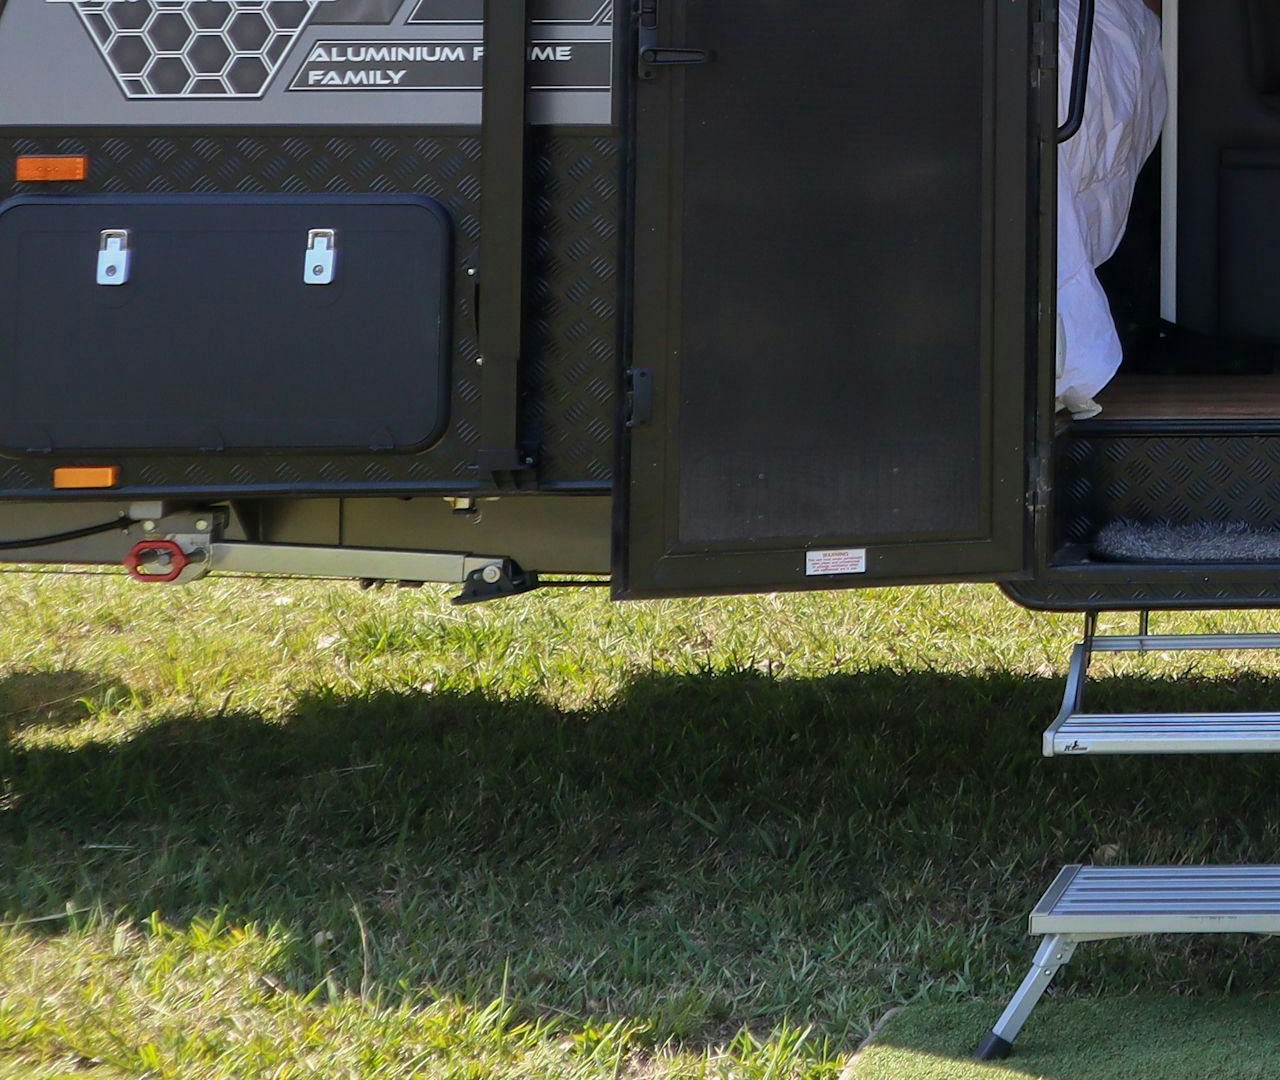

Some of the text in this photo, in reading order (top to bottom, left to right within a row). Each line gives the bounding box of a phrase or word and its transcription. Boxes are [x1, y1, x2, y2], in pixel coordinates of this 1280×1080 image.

[307, 46, 573, 62] ALUMINIUM FME
[307, 70, 407, 85] FAMILY
